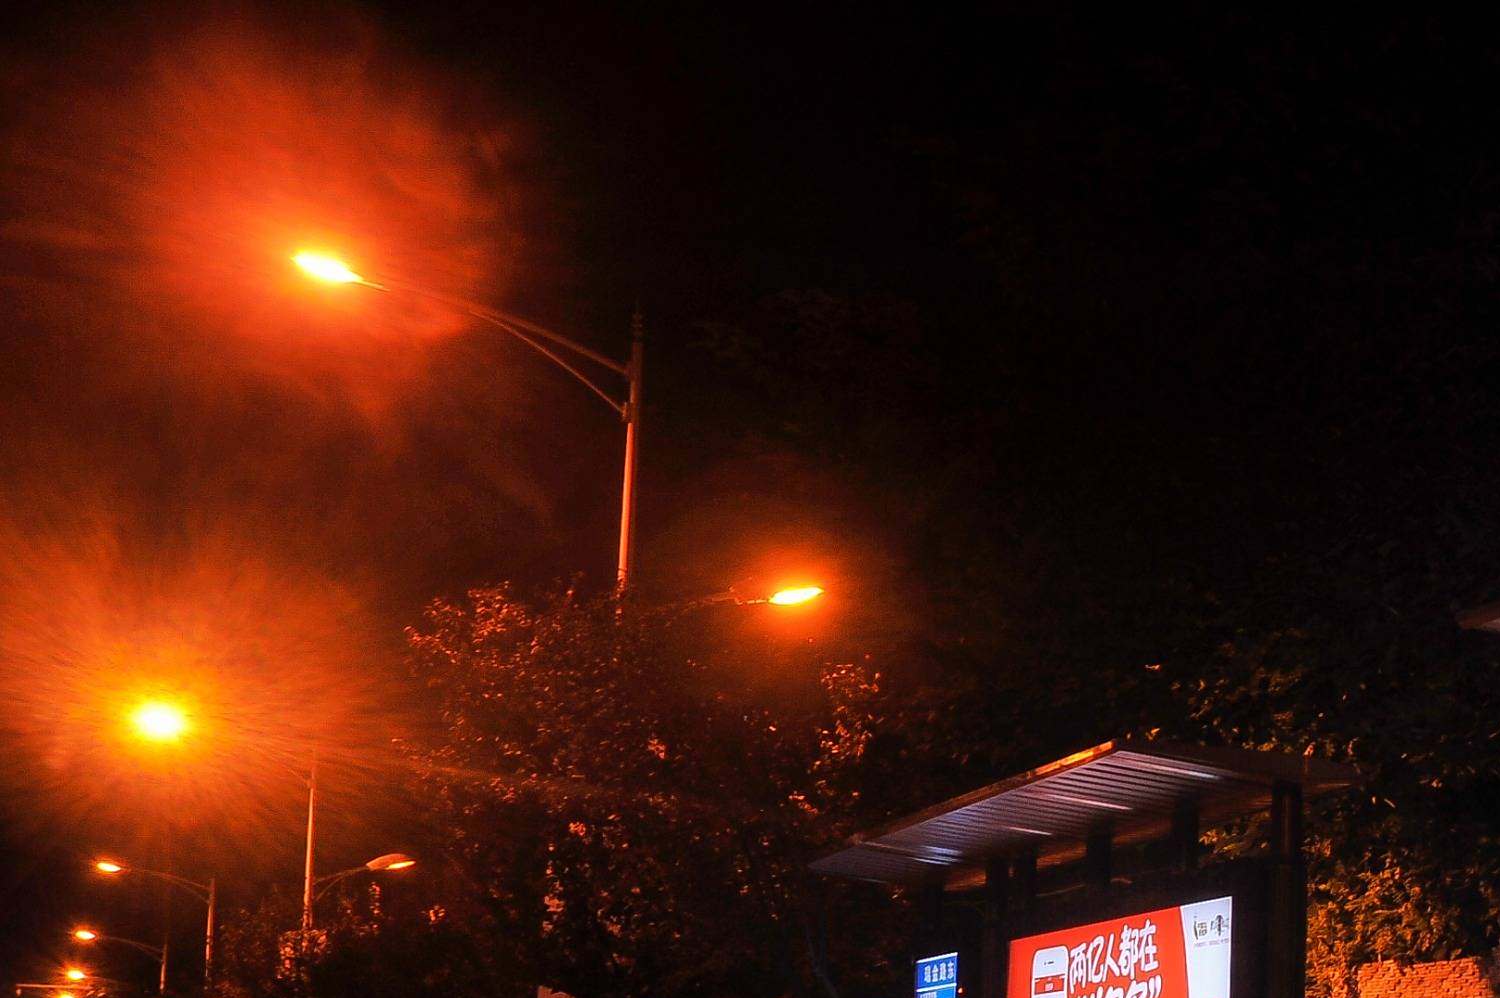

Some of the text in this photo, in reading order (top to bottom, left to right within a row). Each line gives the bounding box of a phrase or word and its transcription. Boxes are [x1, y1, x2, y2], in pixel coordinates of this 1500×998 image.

[1069, 918, 1160, 994] 两亿人都在
